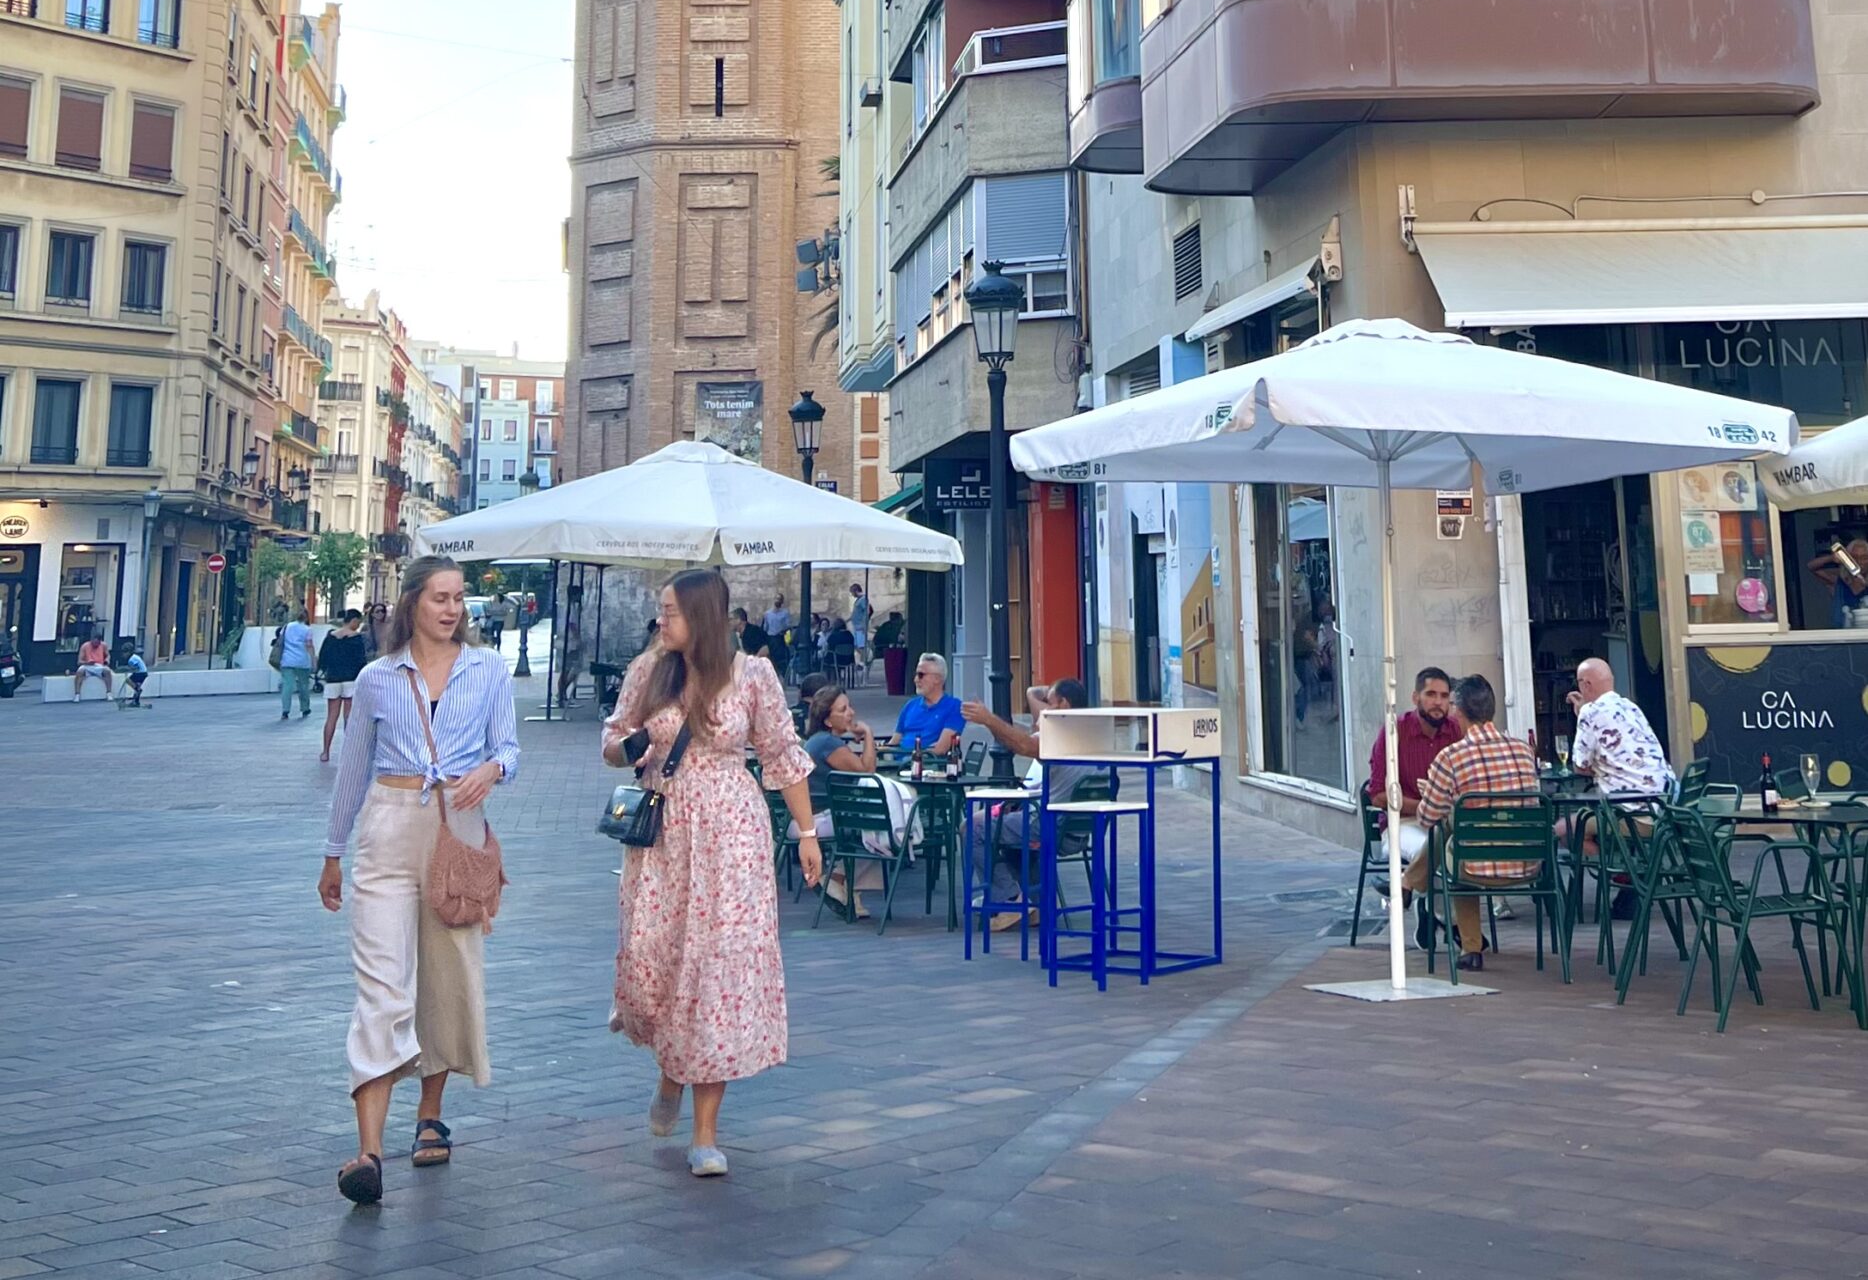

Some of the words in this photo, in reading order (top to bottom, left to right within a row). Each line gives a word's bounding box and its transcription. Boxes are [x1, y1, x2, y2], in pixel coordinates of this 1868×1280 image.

[1680, 337, 1838, 368] LUCINA
[704, 400, 725, 409] Tots
[727, 399, 754, 409] tenim
[717, 410, 741, 418] mare
[1706, 425, 1721, 438] 18
[1761, 430, 1777, 442] 42
[937, 486, 991, 498] LELE
[438, 540, 474, 554] AMBAR
[742, 540, 775, 555] AMBAR
[1761, 691, 1796, 709] CA
[1742, 710, 1834, 729] LUCINA
